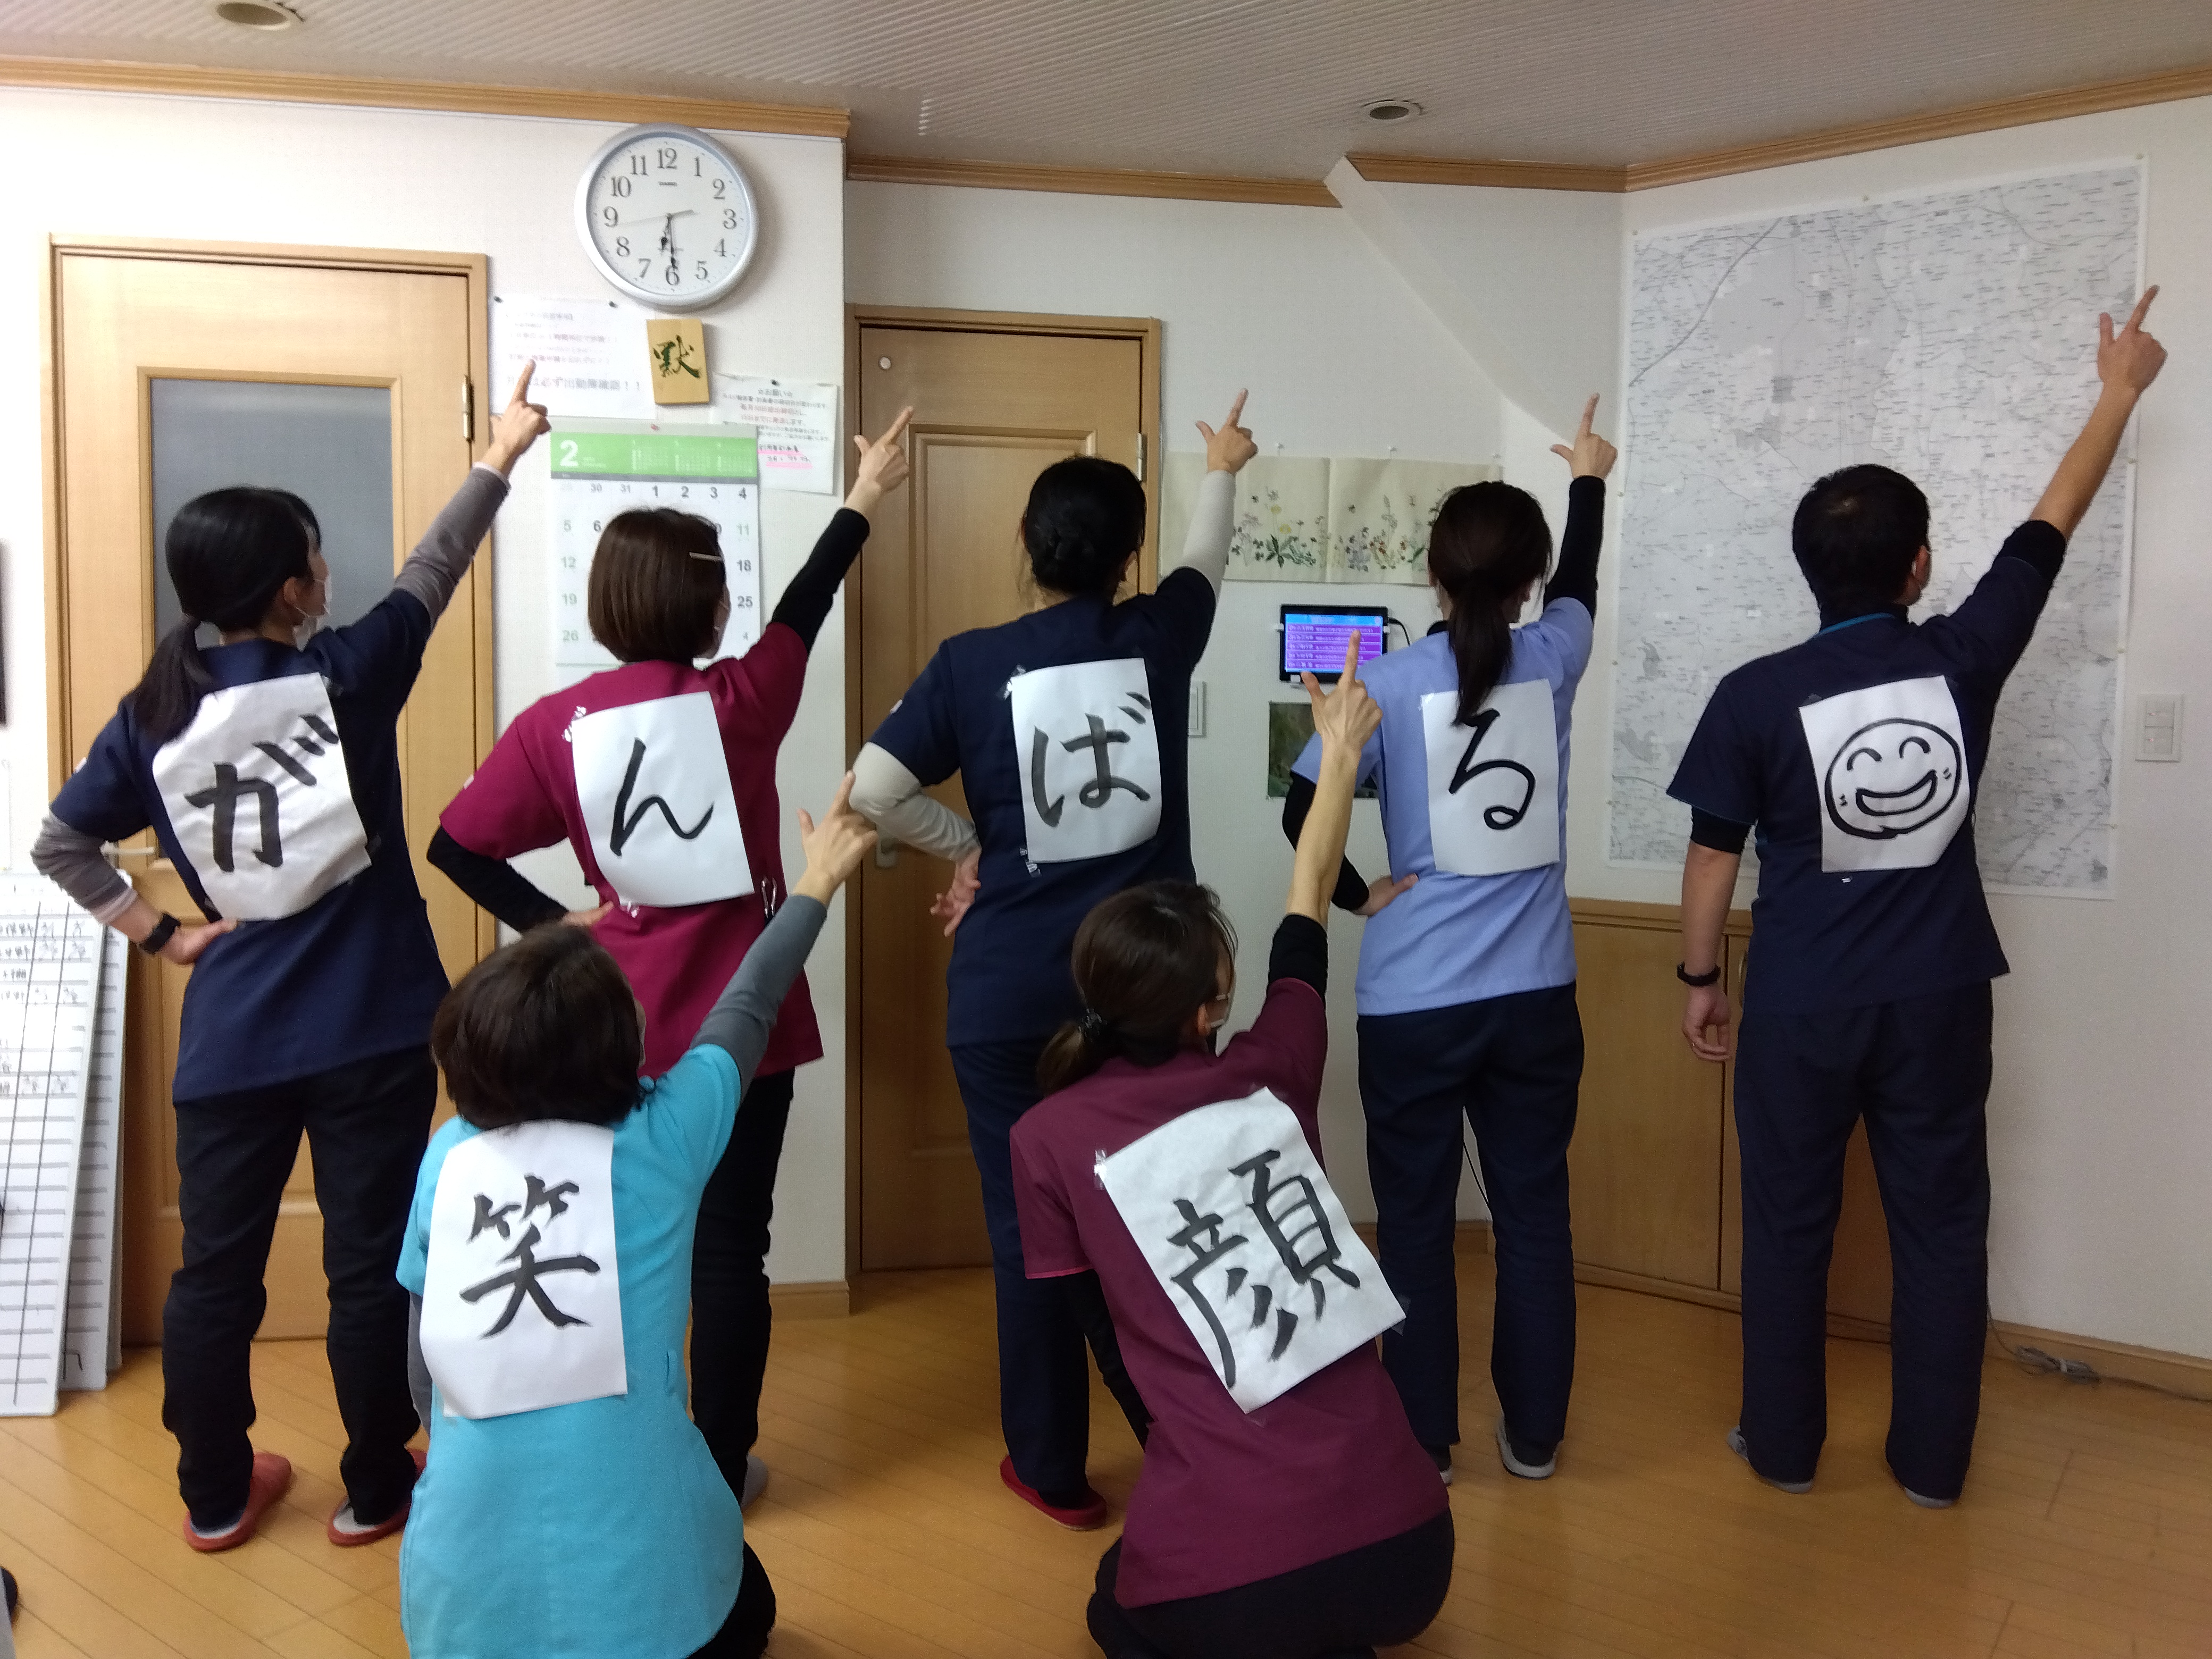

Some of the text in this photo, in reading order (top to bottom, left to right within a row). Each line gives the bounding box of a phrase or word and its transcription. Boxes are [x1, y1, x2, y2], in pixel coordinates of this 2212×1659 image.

[631, 155, 648, 175] 11
[657, 148, 677, 169] 12
[694, 156, 701, 177] 1
[611, 176, 632, 197] 10
[713, 179, 725, 199] 2
[604, 206, 618, 227] 9
[723, 208, 736, 229] 3
[616, 237, 630, 257] 8
[714, 238, 726, 257] 4
[638, 258, 651, 278] 7
[666, 265, 680, 286] 6
[696, 261, 708, 280] 5
[560, 440, 579, 467] 2
[591, 483, 602, 492] 30
[621, 484, 631, 493] 31
[652, 485, 658, 498] 1
[681, 486, 689, 498] 2
[710, 487, 718, 499] 3
[738, 487, 747, 499] 4
[564, 519, 571, 532] 5
[593, 520, 601, 532] 6
[736, 523, 749, 535] 11
[736, 559, 751, 572] 18
[562, 593, 577, 605] 19
[738, 596, 753, 608] 25
[1032, 691, 1151, 827] ば
[1448, 708, 1536, 831] る
[184, 714, 339, 873] が
[610, 737, 714, 858] ん
[459, 1173, 600, 1340] 笑
[1167, 1149, 1361, 1389] 顔
